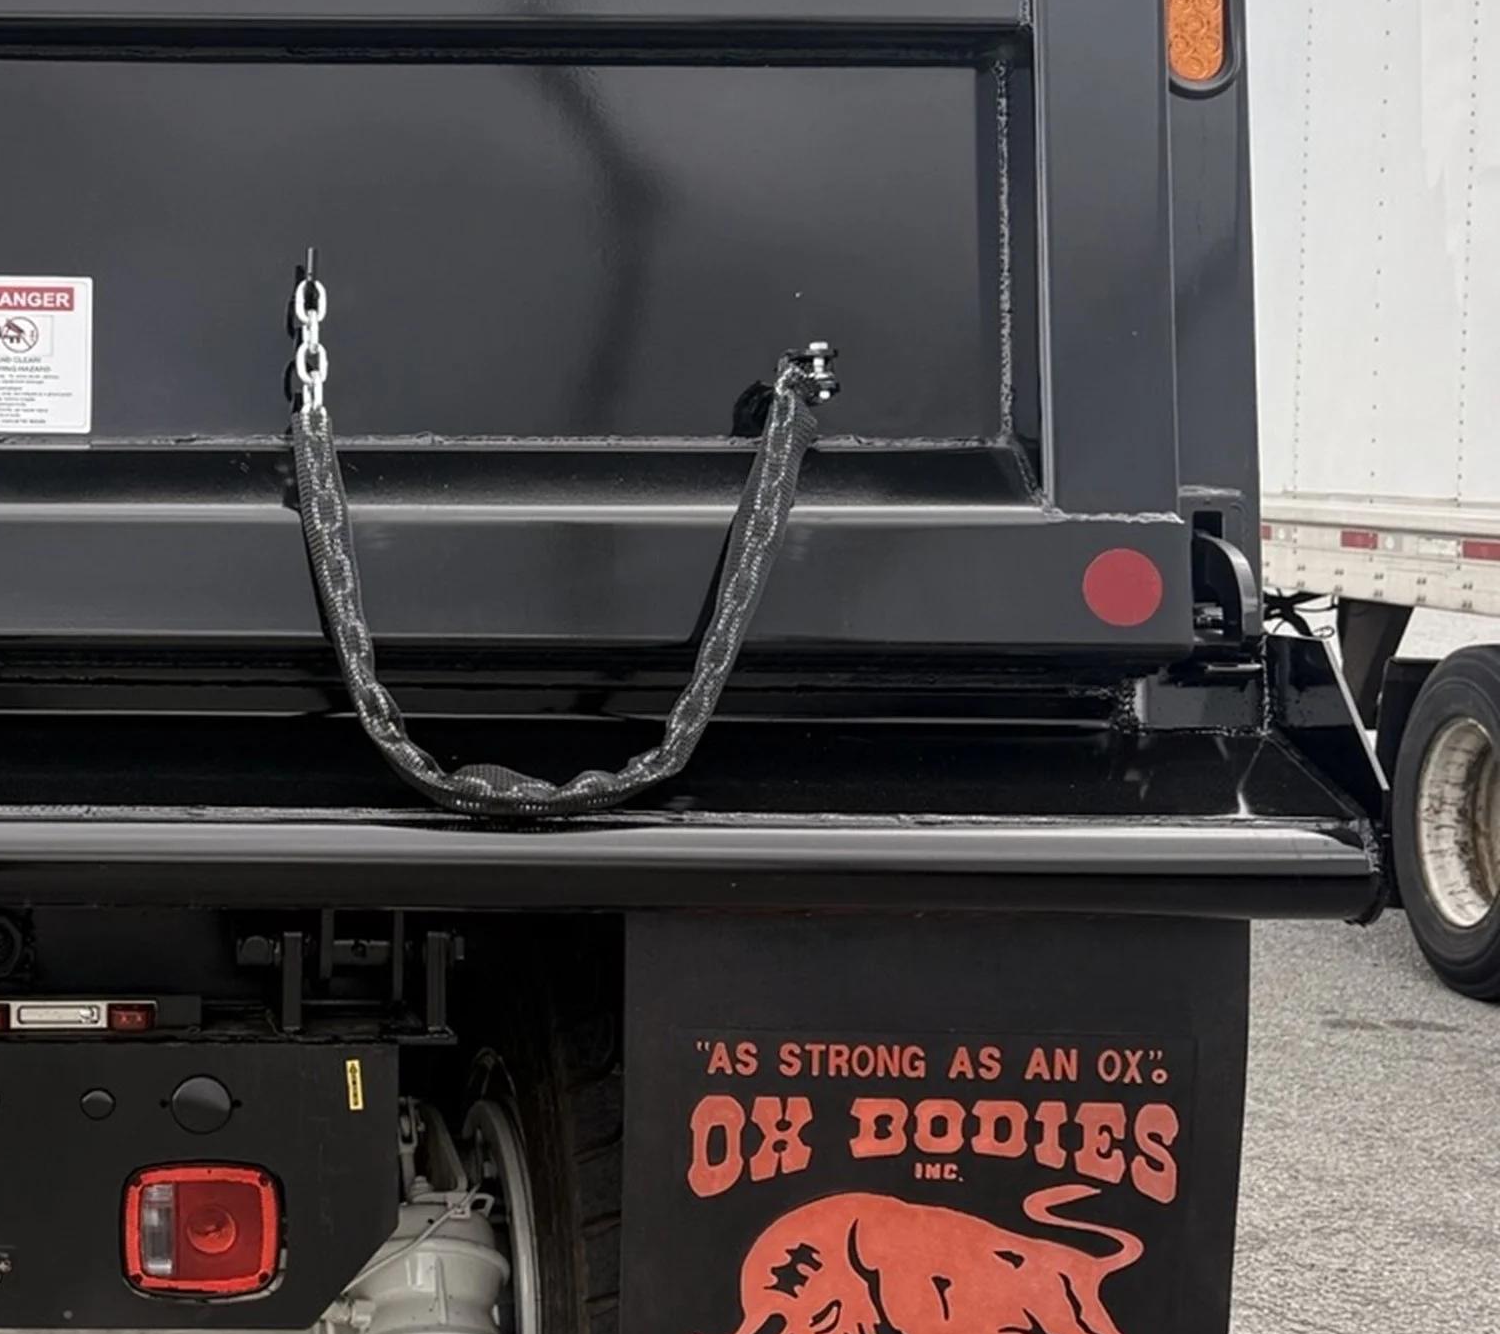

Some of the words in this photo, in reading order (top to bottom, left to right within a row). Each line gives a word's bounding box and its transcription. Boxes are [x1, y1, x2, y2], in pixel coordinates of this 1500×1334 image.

[778, 1042, 926, 1079] STRONG
[947, 1046, 1002, 1080] AS
[1024, 1047, 1078, 1081] AN
[687, 1094, 814, 1198] OX
[848, 1097, 1180, 1204] BODIES
[914, 1161, 965, 1183] INC.
